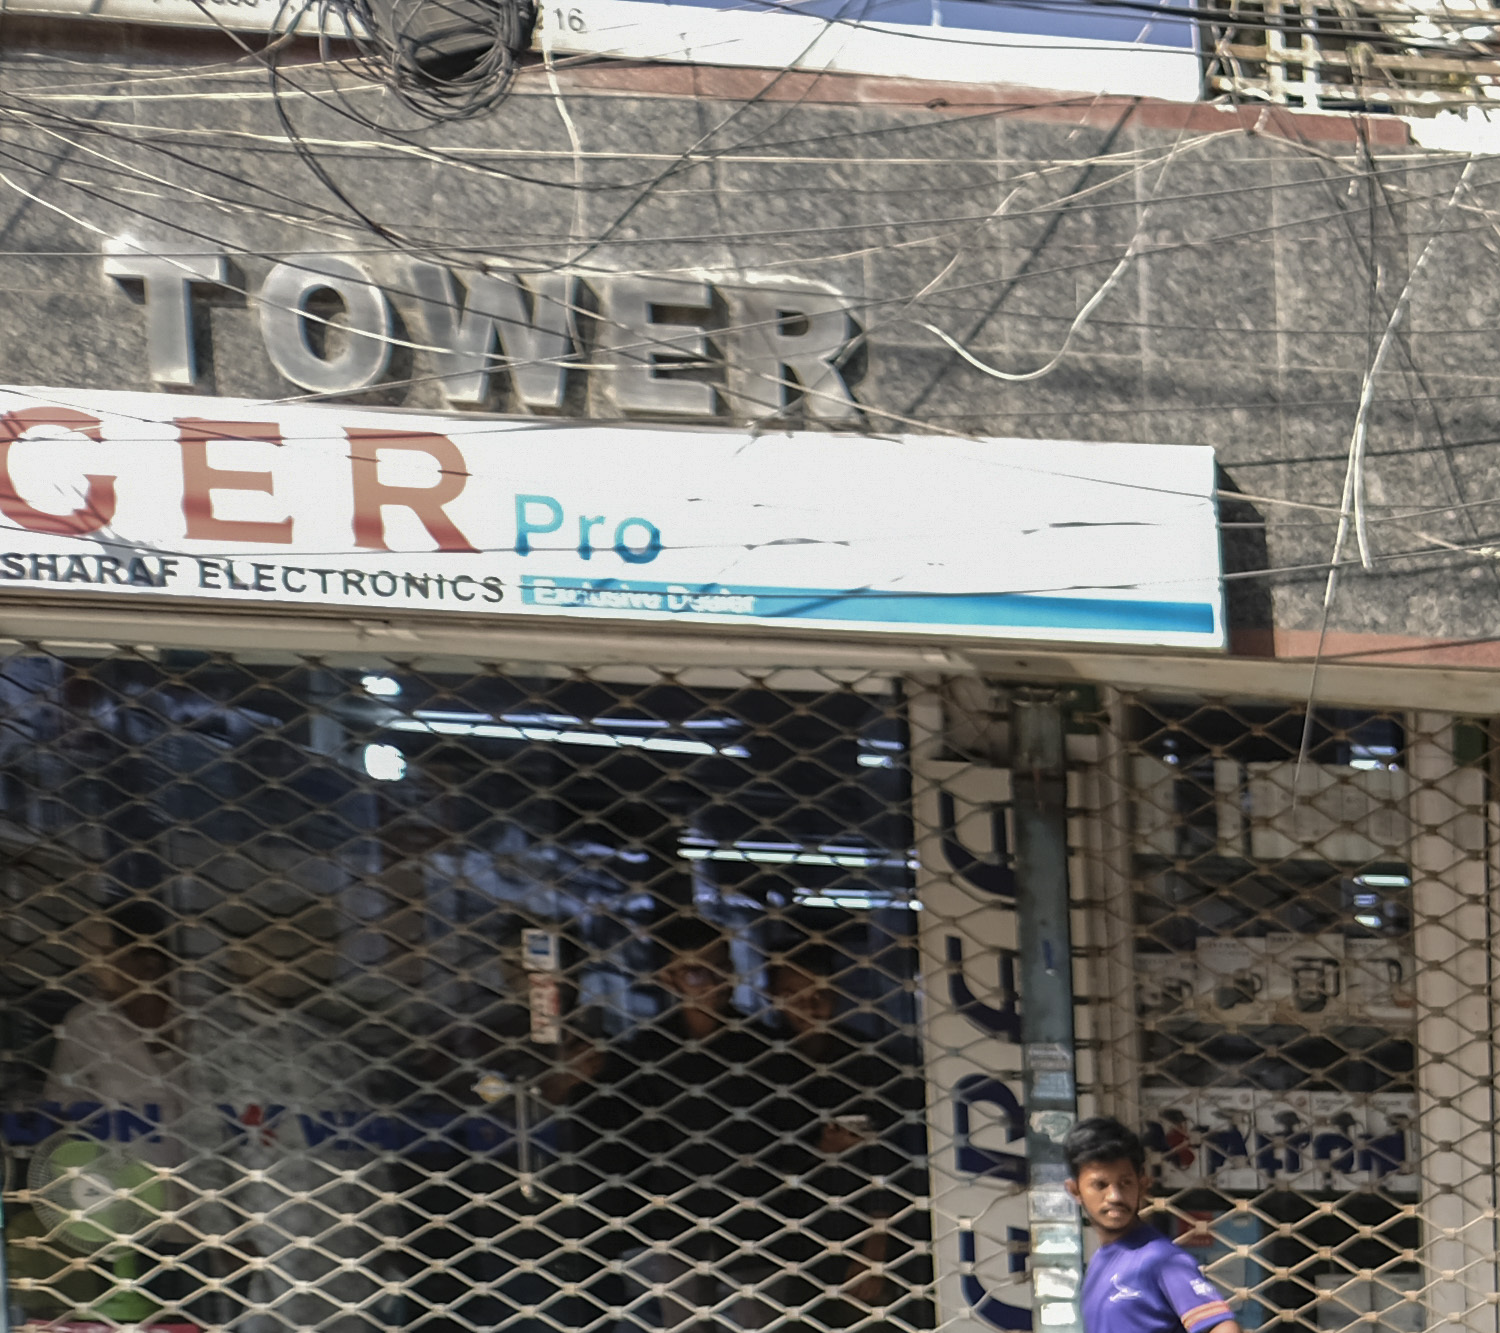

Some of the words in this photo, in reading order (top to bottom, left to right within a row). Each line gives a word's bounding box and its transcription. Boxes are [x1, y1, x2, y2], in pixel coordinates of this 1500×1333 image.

[102, 236, 862, 423] TOWER
[514, 494, 664, 564] Pro
[0, 552, 179, 588] SHARAF
[199, 560, 504, 603] ELECTRONICS
